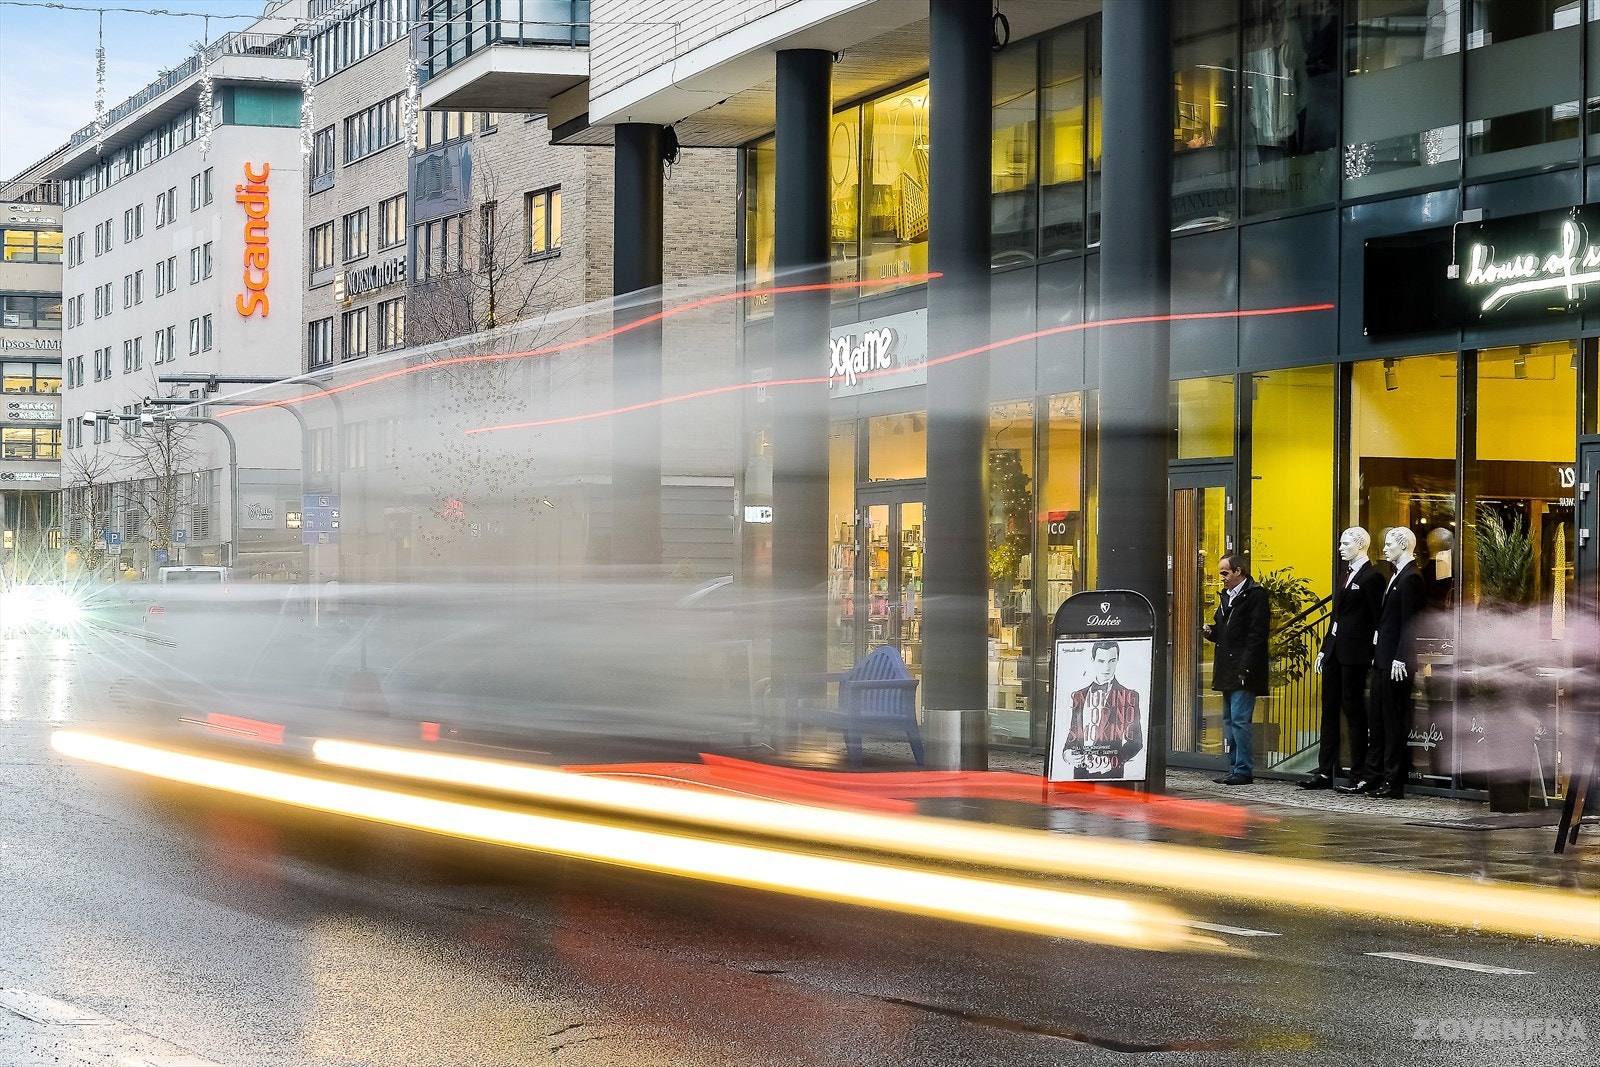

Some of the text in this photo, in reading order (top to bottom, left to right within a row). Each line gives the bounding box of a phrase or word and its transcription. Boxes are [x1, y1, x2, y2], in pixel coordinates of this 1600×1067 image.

[235, 162, 270, 317] Scandic
[1467, 243, 1537, 285] house
[1542, 221, 1576, 300] of
[346, 266, 379, 297] NORSK
[111, 533, 118, 542] P
[177, 531, 183, 541] P
[1087, 615, 1121, 626] Duke's
[1071, 690, 1135, 708] SMOKING
[1091, 706, 1134, 725] OR NO
[1068, 723, 1133, 742] SMOKING
[1408, 723, 1443, 750] singles
